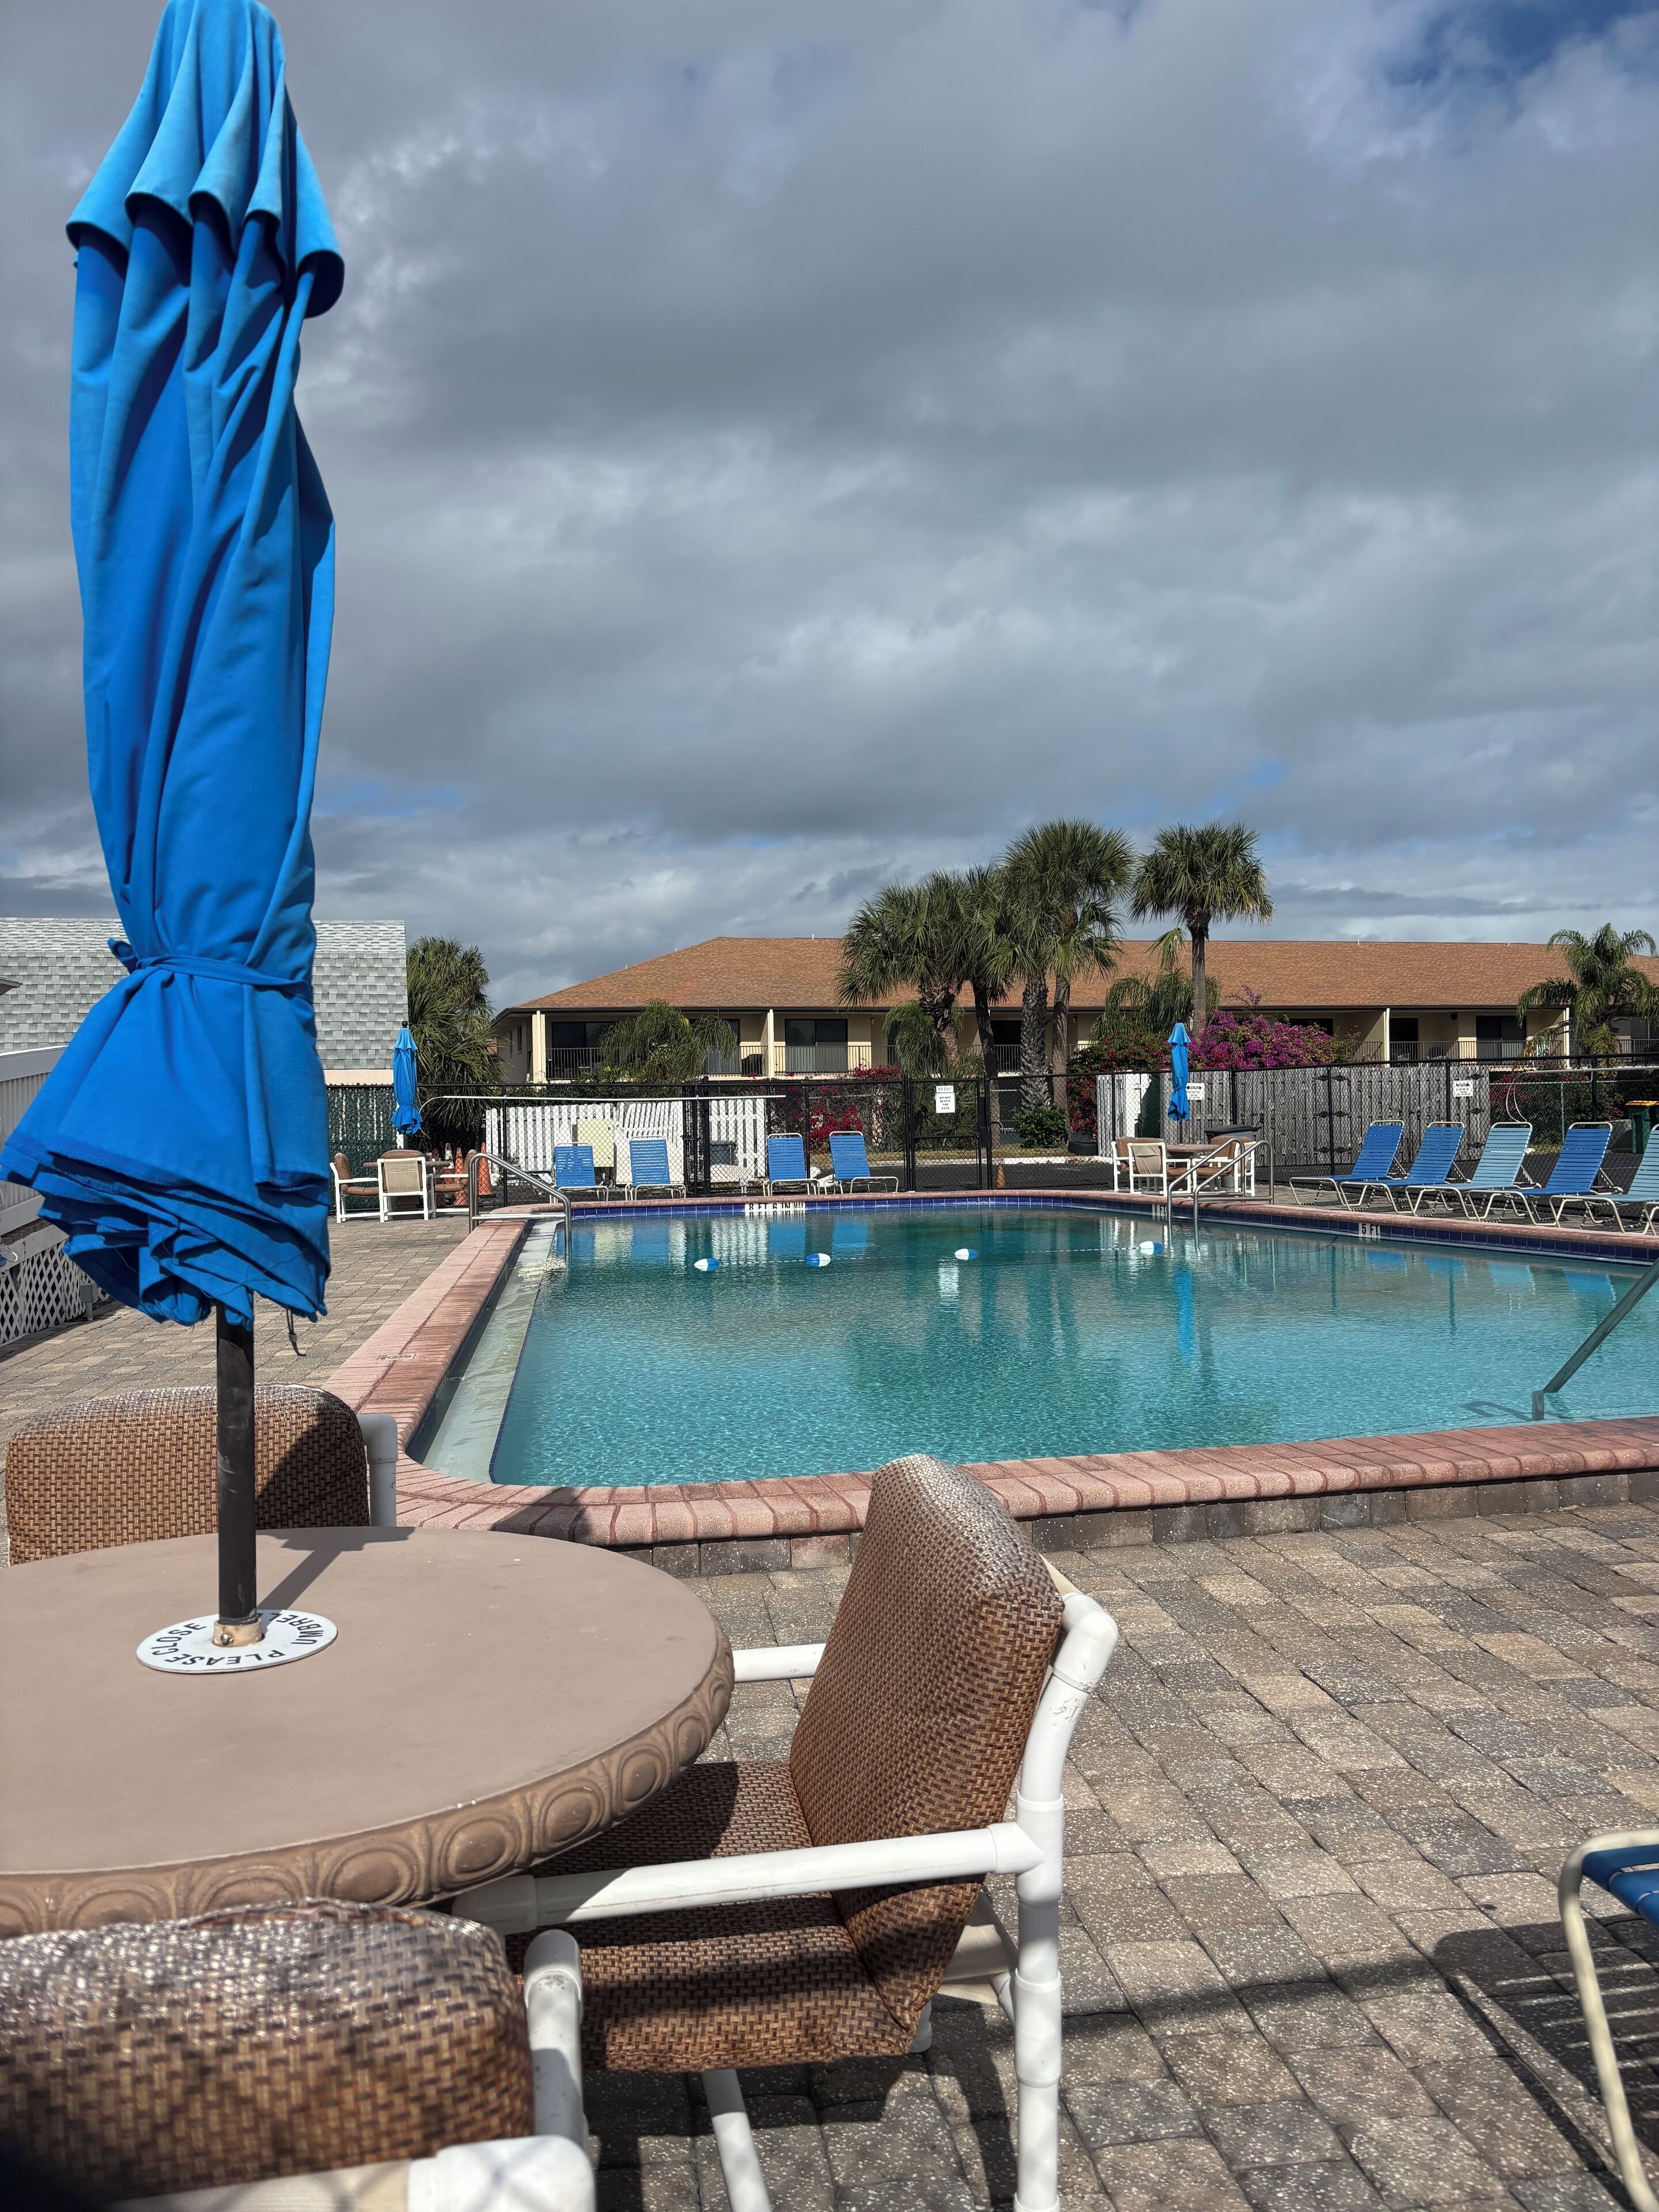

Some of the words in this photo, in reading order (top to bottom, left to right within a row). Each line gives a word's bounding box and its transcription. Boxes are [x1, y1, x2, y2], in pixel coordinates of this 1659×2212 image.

[749, 1203, 754, 1211] 8
[1154, 1204, 1158, 1214] 8
[1362, 1223, 1366, 1234] 5
[1370, 1223, 1380, 1236] FT.
[151, 1623, 208, 1656] CLOSE
[164, 1649, 286, 1665] PLEASE
